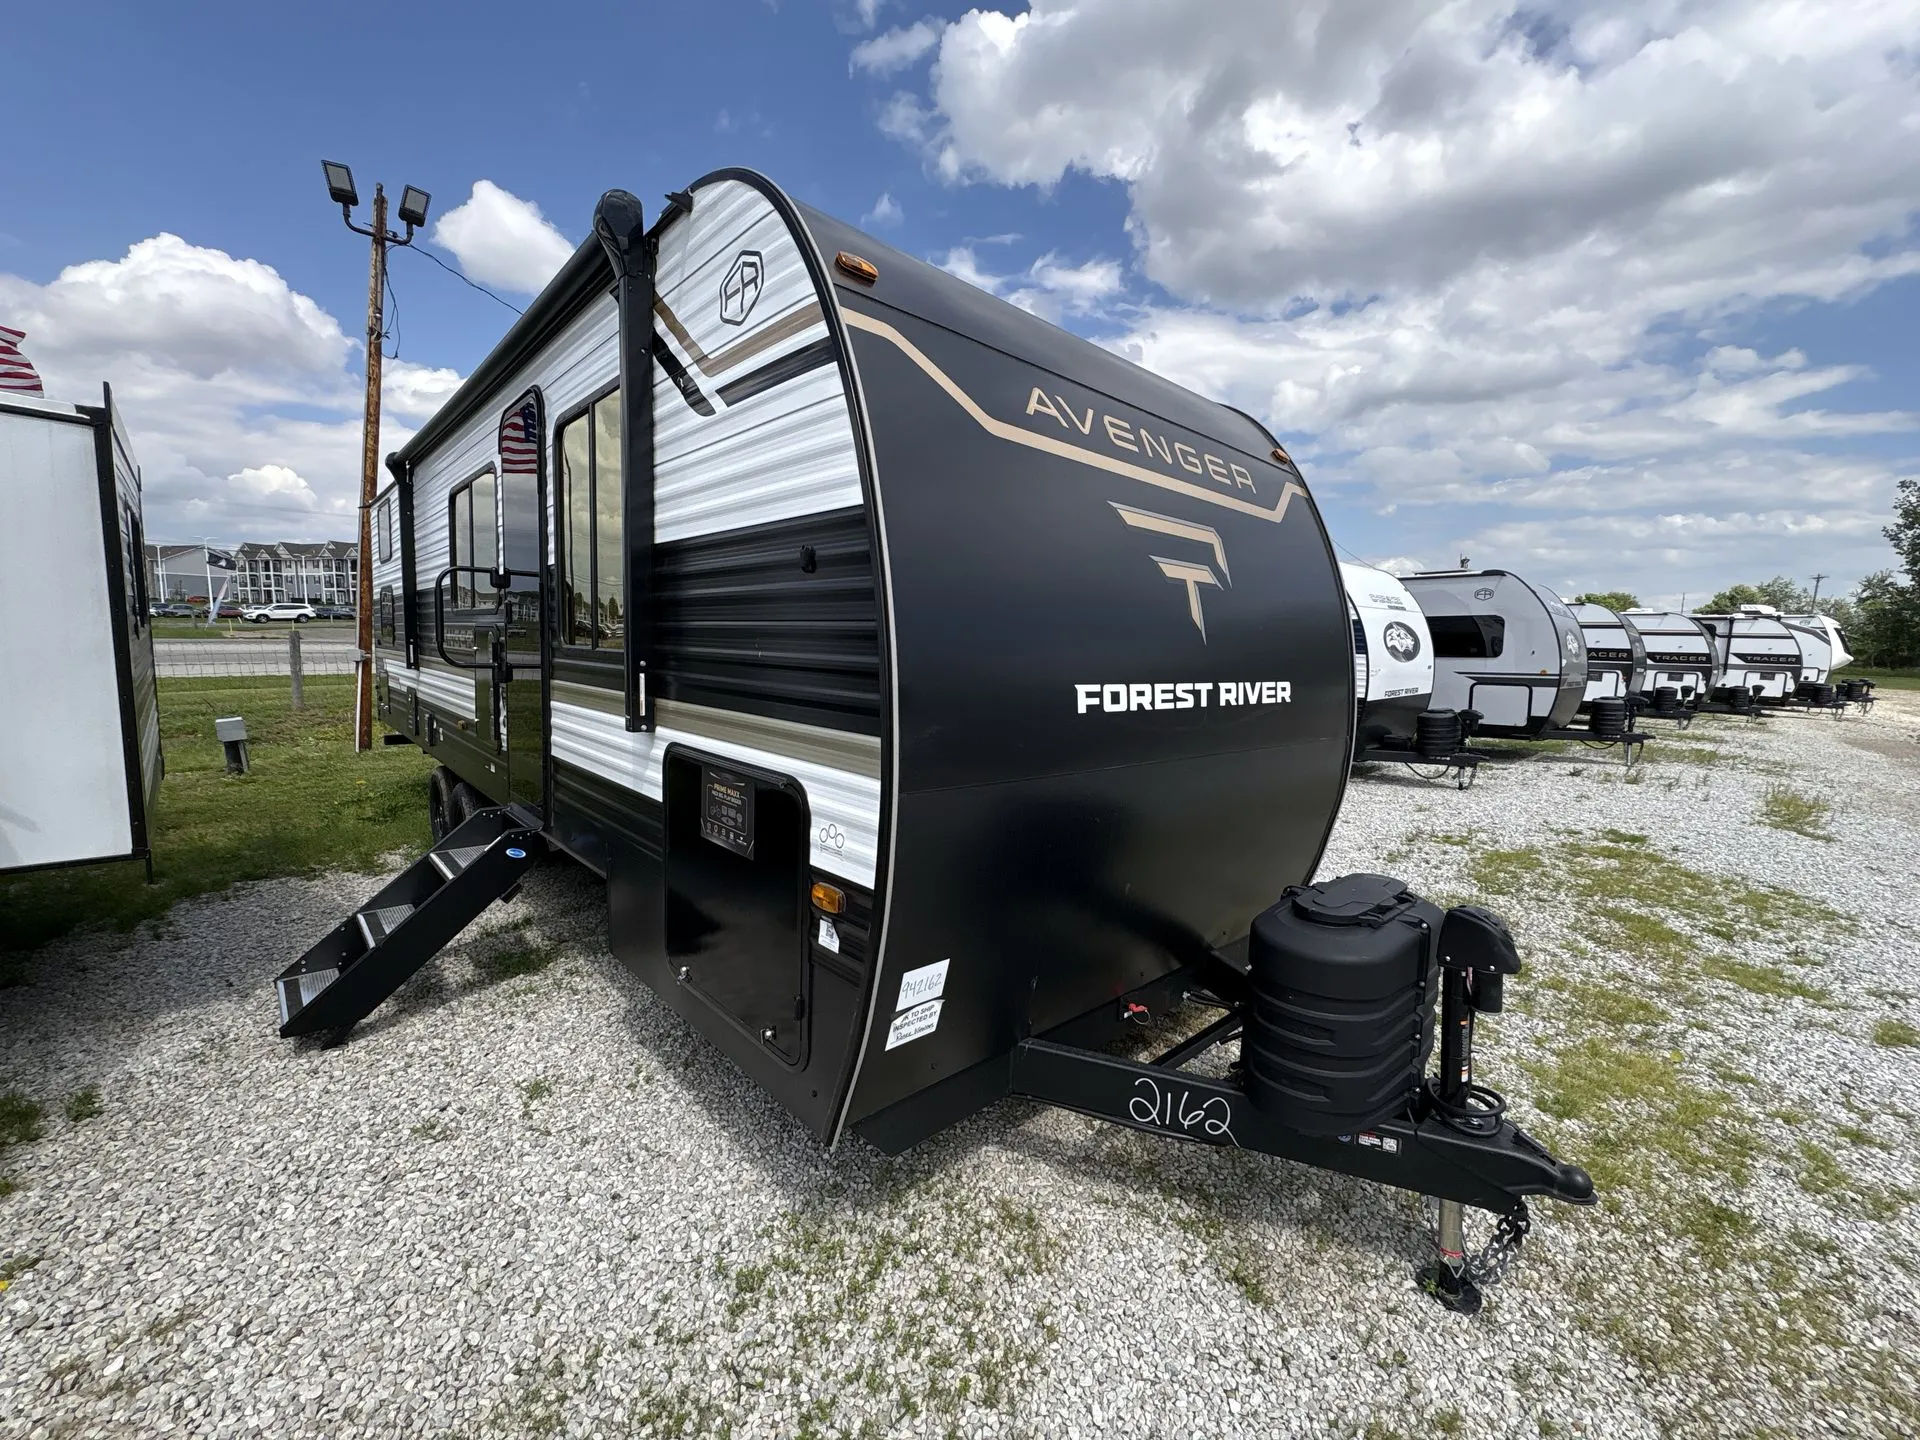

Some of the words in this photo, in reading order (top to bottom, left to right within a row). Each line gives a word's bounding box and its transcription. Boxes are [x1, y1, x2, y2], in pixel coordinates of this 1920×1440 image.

[1025, 386, 1257, 494] AVENGER
[1654, 654, 1707, 662] TRACER
[1746, 655, 1796, 663] TRACER
[1074, 683, 1214, 714] FOREST
[1218, 681, 1292, 706] RIVER
[1384, 689, 1404, 698] FOREST
[1404, 687, 1419, 695] RIVER
[902, 972, 942, 999] 942162
[893, 1014, 928, 1032] INSPECTED
[929, 1010, 938, 1018] BY
[911, 1010, 919, 1018] TO
[921, 1004, 935, 1014] SHIP
[1128, 1077, 1241, 1148] 2162
